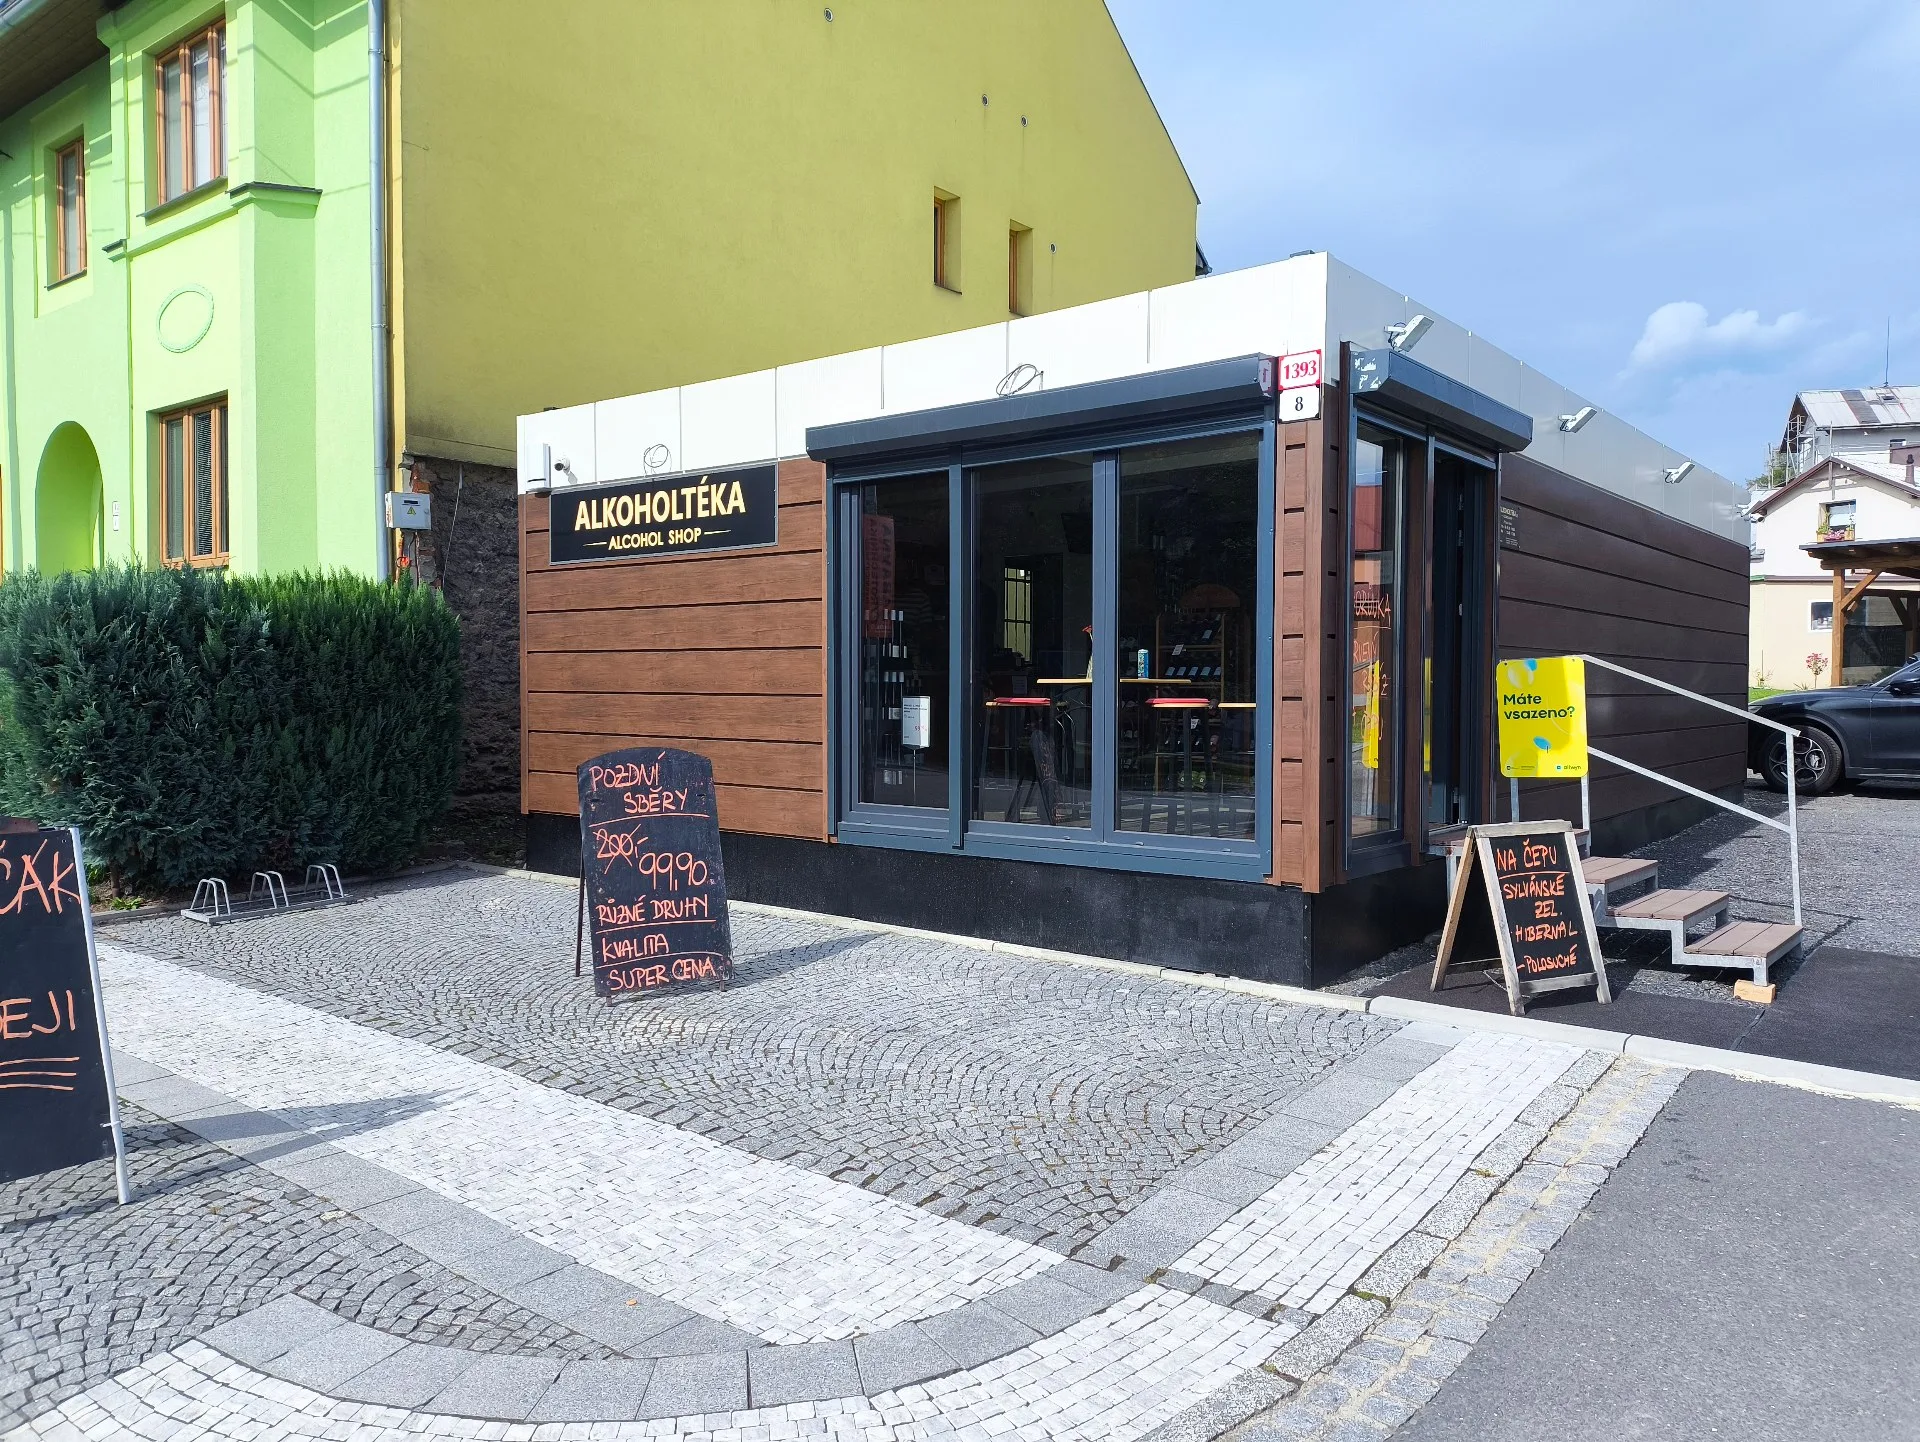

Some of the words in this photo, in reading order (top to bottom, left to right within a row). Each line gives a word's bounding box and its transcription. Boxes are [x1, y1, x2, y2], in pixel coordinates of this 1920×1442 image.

[1284, 360, 1317, 380] 1393
[1295, 396, 1303, 411] 8
[574, 475, 746, 531] ALKOHOLTÉKA
[608, 531, 664, 550] ALCOHOL
[668, 528, 702, 545] SHOP
[1503, 693, 1542, 706] Máte
[1504, 706, 1575, 720] vsazeno?
[589, 751, 666, 791] POZDNÍ
[624, 786, 688, 813] SBĚRY
[1496, 848, 1516, 871] NA
[1523, 838, 1557, 868] ČEPU
[639, 852, 708, 892] 99,90
[1503, 873, 1566, 899] SYLVÁNSKÉ
[596, 895, 646, 925] RŮZNÉ
[650, 894, 708, 920] DRUHY
[1515, 920, 1578, 942] HIBERNAL
[602, 933, 669, 963] KVALITA
[609, 965, 669, 990] SUPER
[672, 956, 717, 981] CENA
[0, 990, 76, 1039] EJI
